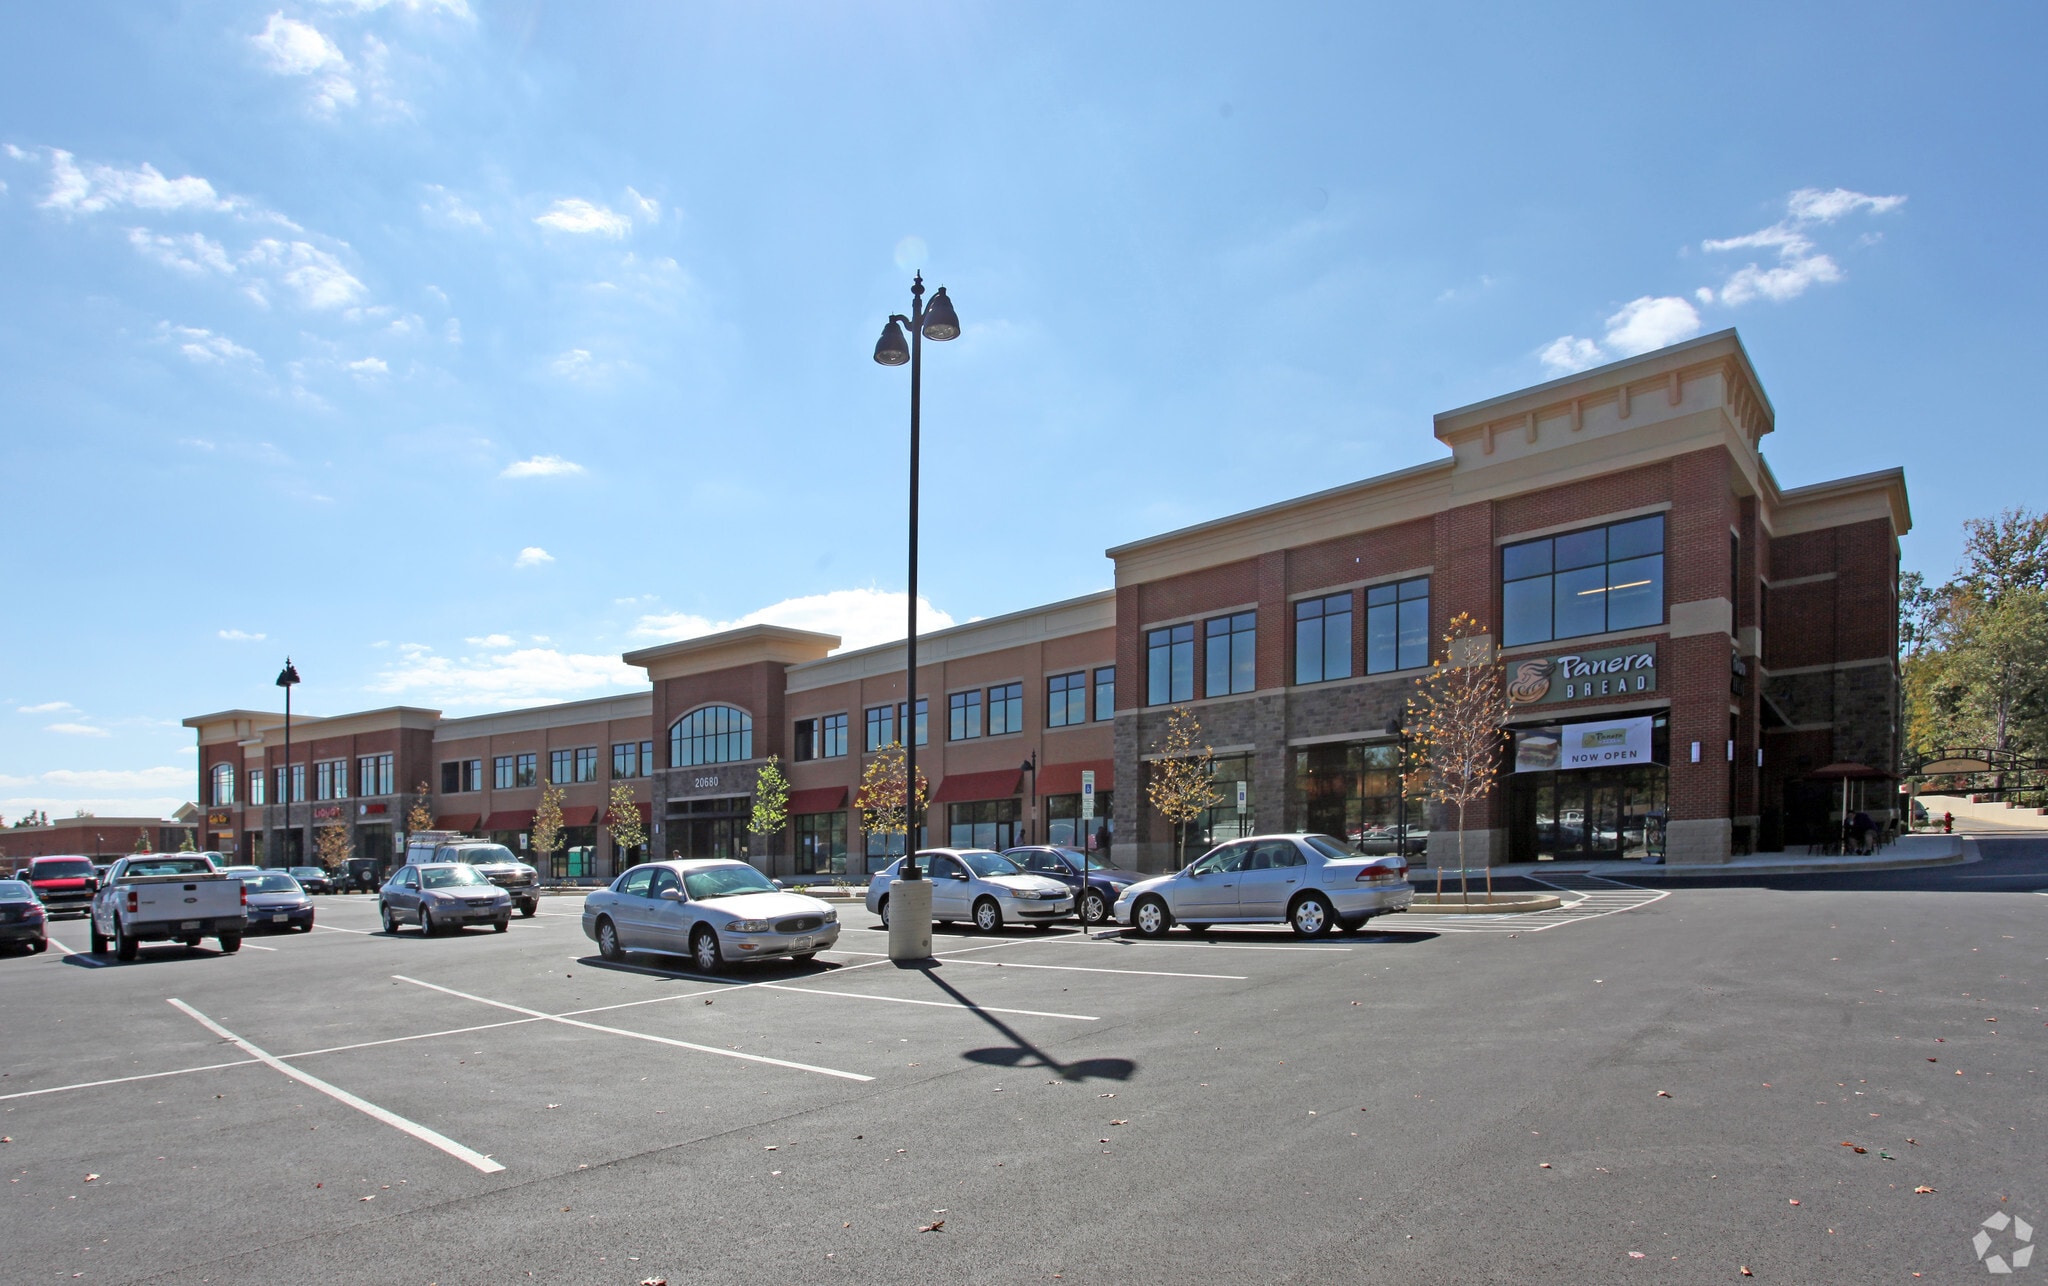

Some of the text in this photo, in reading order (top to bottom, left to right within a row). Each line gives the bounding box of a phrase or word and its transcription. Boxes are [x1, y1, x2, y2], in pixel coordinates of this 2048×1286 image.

[1557, 653, 1654, 679] Panera
[1566, 675, 1646, 698] BREAD
[1572, 750, 1637, 763] NOW OPEN
[695, 776, 719, 788] 20680
